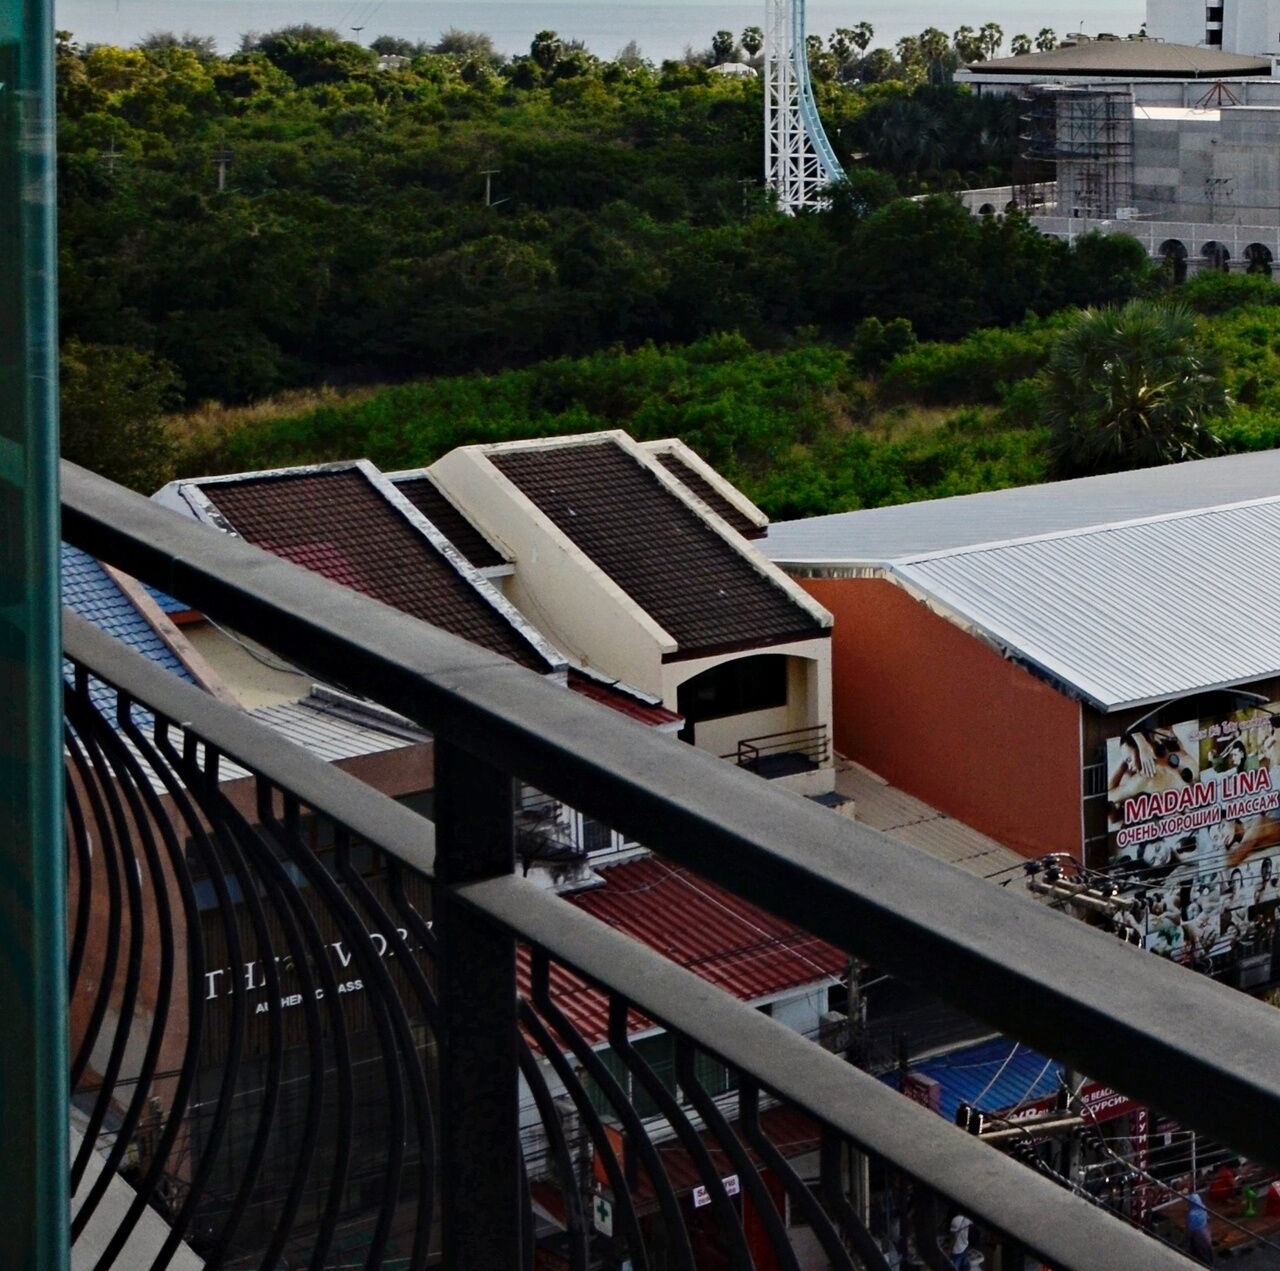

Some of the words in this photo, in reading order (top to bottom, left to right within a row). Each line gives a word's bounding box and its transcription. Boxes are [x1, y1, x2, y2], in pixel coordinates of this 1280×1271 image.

[1117, 825, 1160, 847] ОЧЕНЬ
[1159, 805, 1222, 837] ХОРОШИЙ
[1225, 791, 1280, 821] МАССАЖ
[1124, 780, 1217, 825] MADAM
[1221, 767, 1273, 801] LINA
